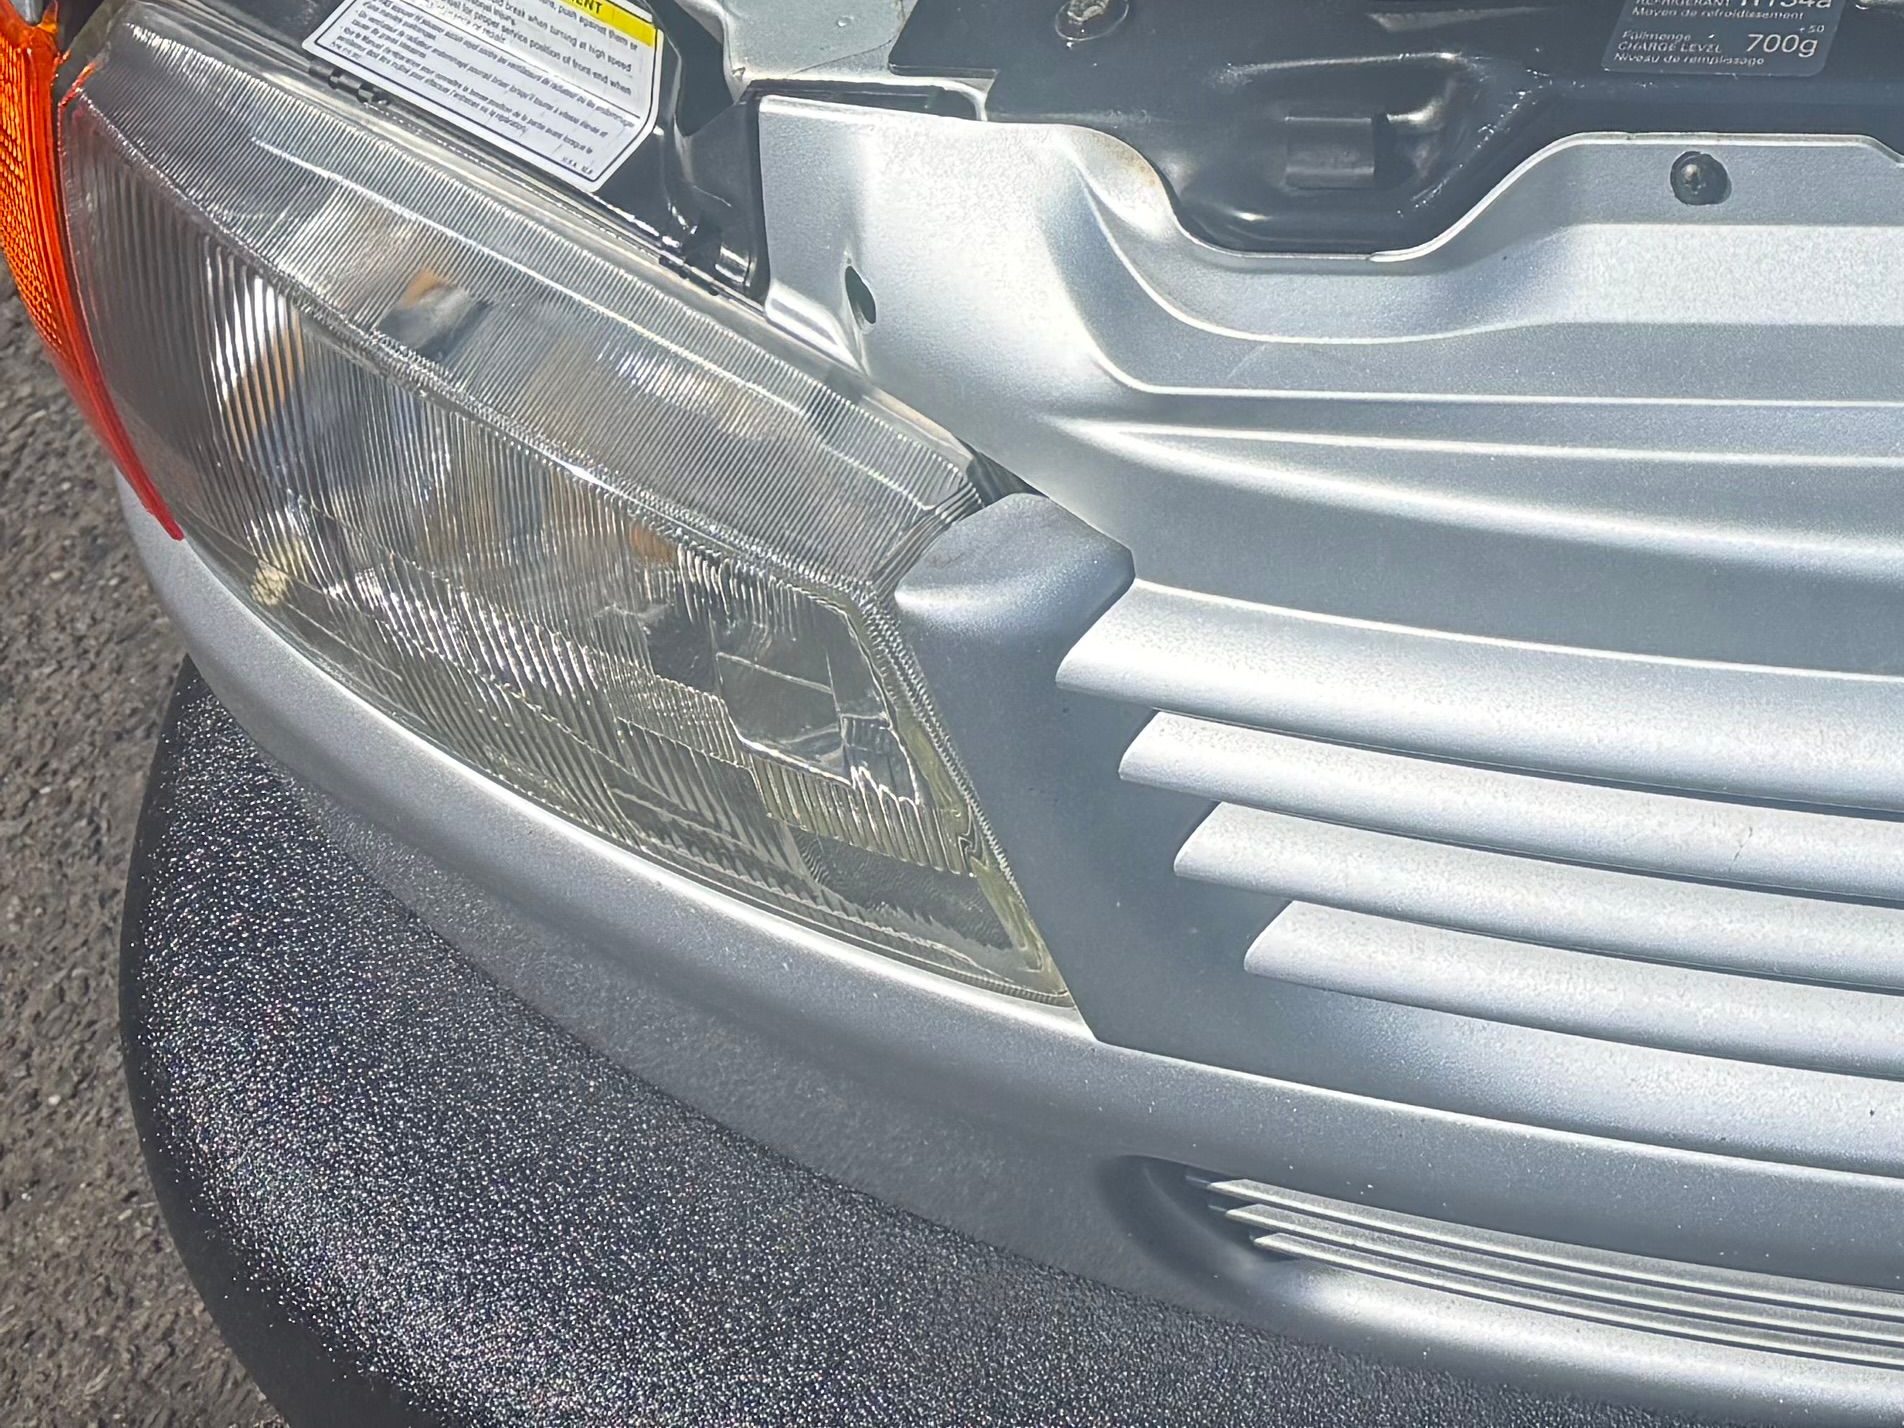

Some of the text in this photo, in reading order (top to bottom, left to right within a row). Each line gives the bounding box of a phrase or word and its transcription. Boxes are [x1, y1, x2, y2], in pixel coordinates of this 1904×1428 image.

[505, 2, 525, 18] break
[528, 15, 548, 30] when
[550, 25, 578, 47] turning
[588, 45, 606, 59] high
[1746, 34, 1818, 57] 700g
